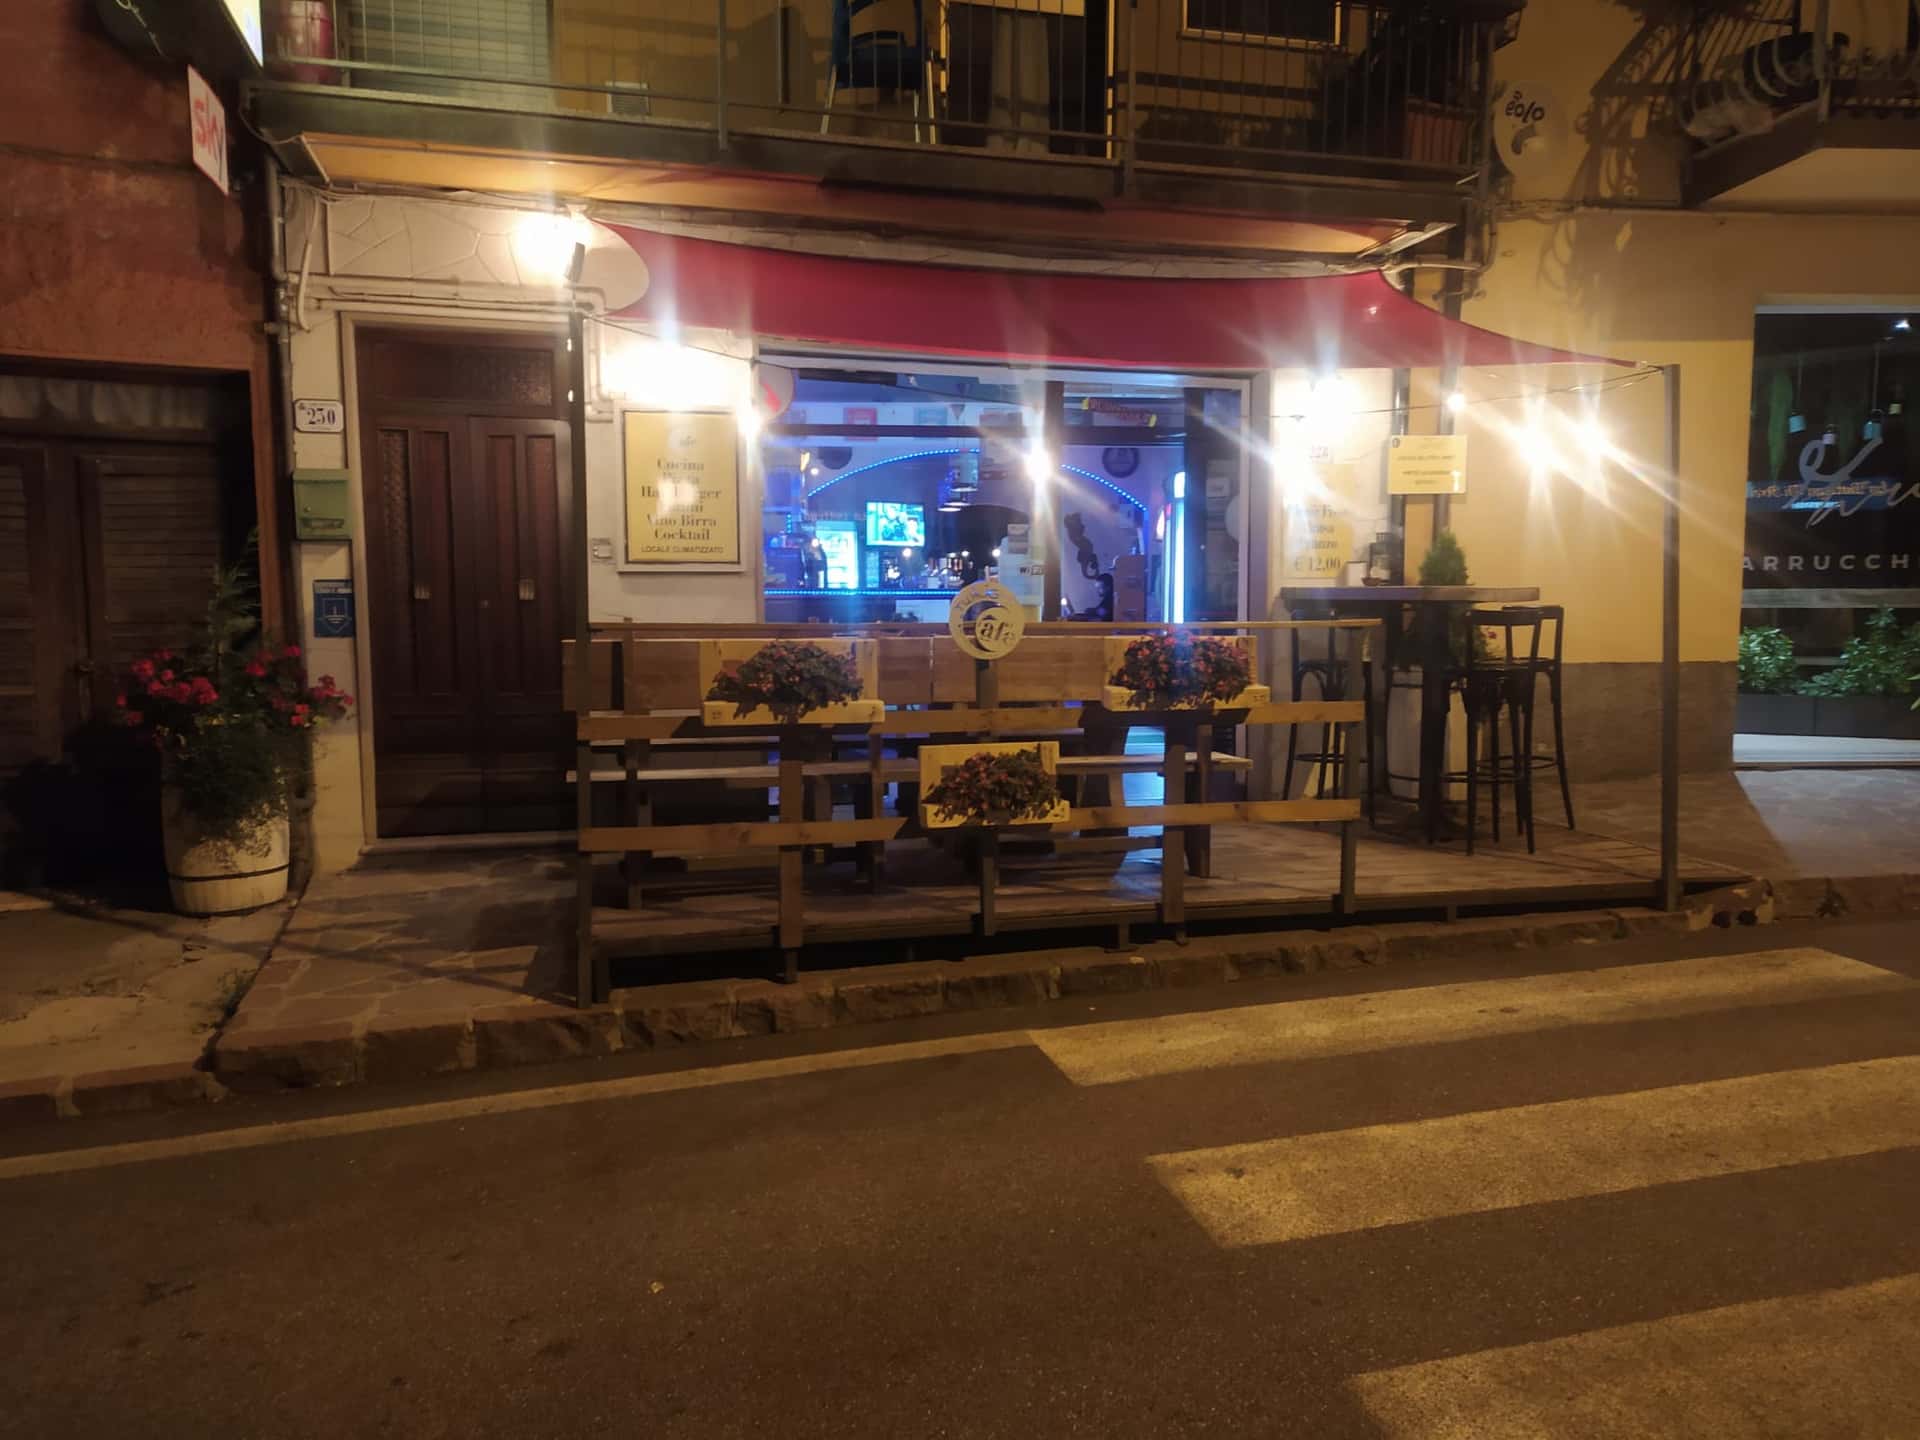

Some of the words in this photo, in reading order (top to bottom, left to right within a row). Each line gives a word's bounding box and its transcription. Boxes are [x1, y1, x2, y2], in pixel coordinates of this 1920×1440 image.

[657, 459, 705, 471] Cucina
[681, 515, 717, 527] Birra
[654, 528, 711, 541] Cocktail
[1743, 554, 1920, 571] ARRUCCH
